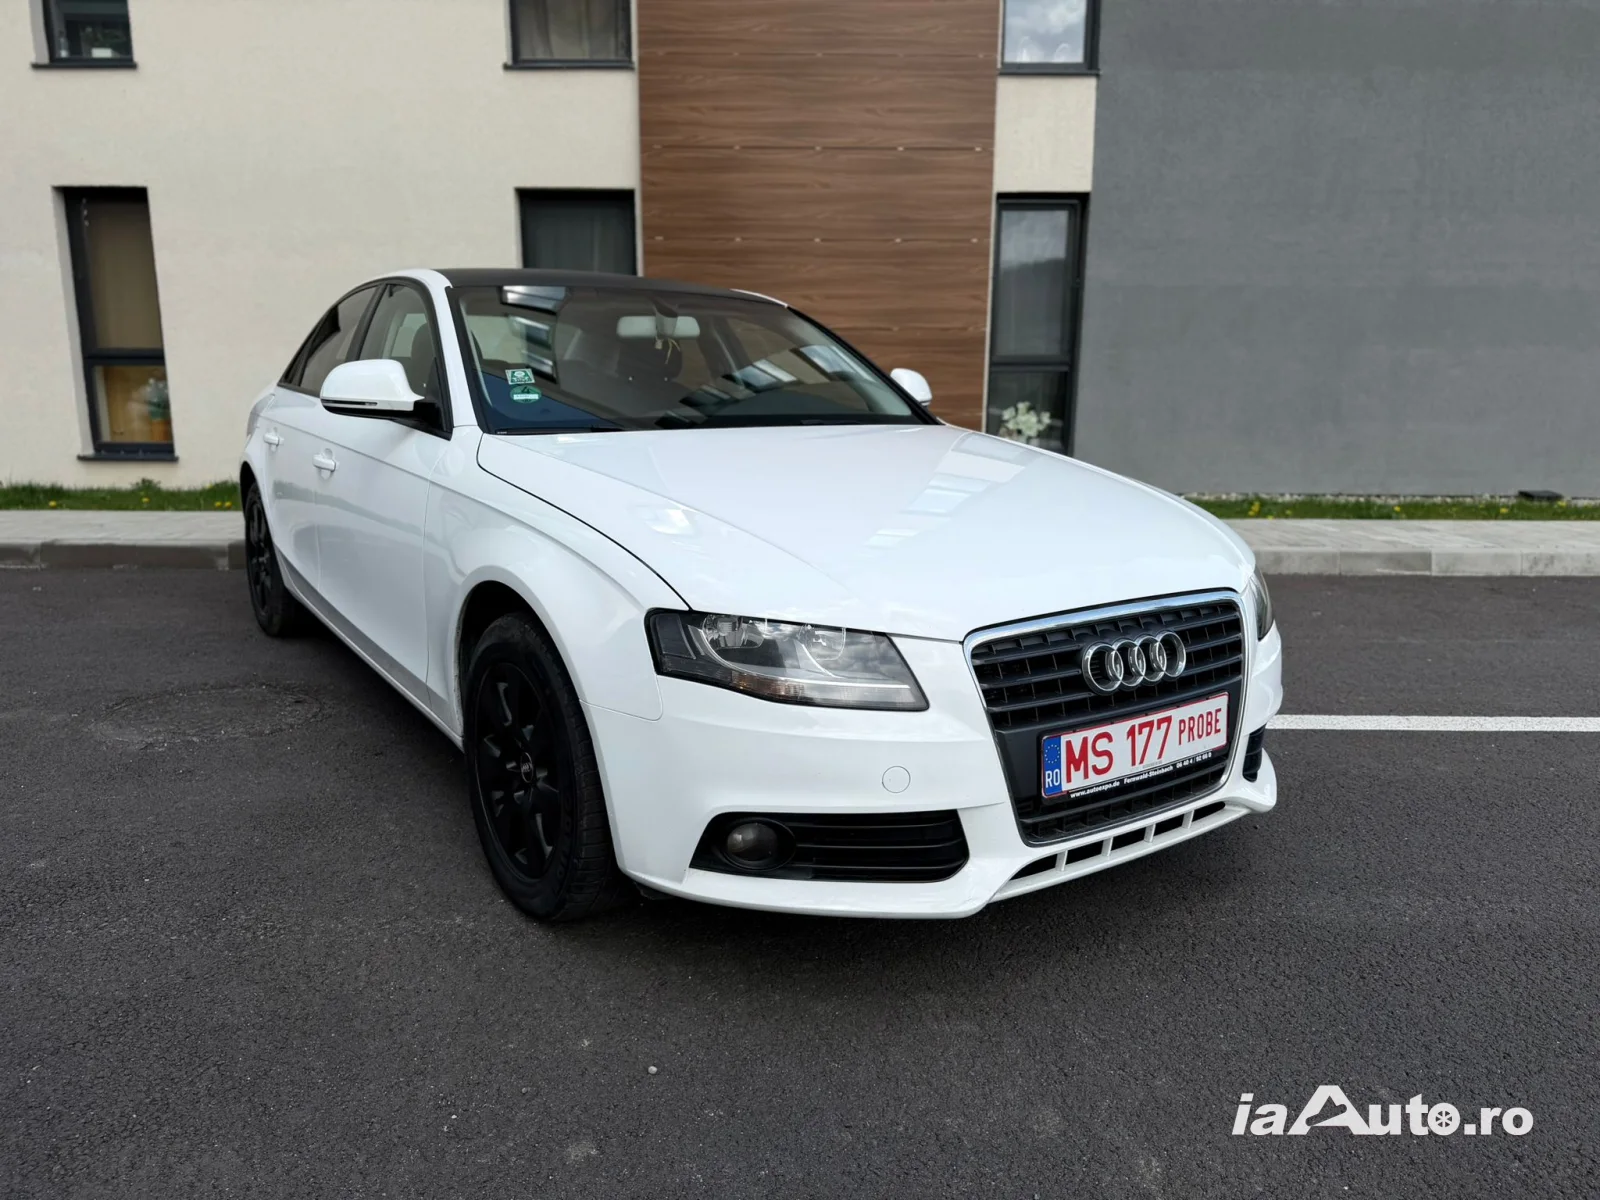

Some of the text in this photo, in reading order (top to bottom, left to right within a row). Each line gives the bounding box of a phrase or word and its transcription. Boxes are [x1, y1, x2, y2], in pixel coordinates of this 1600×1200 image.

[1066, 708, 1222, 783] MS 177 PROBE
[1045, 769, 1061, 788] RO
